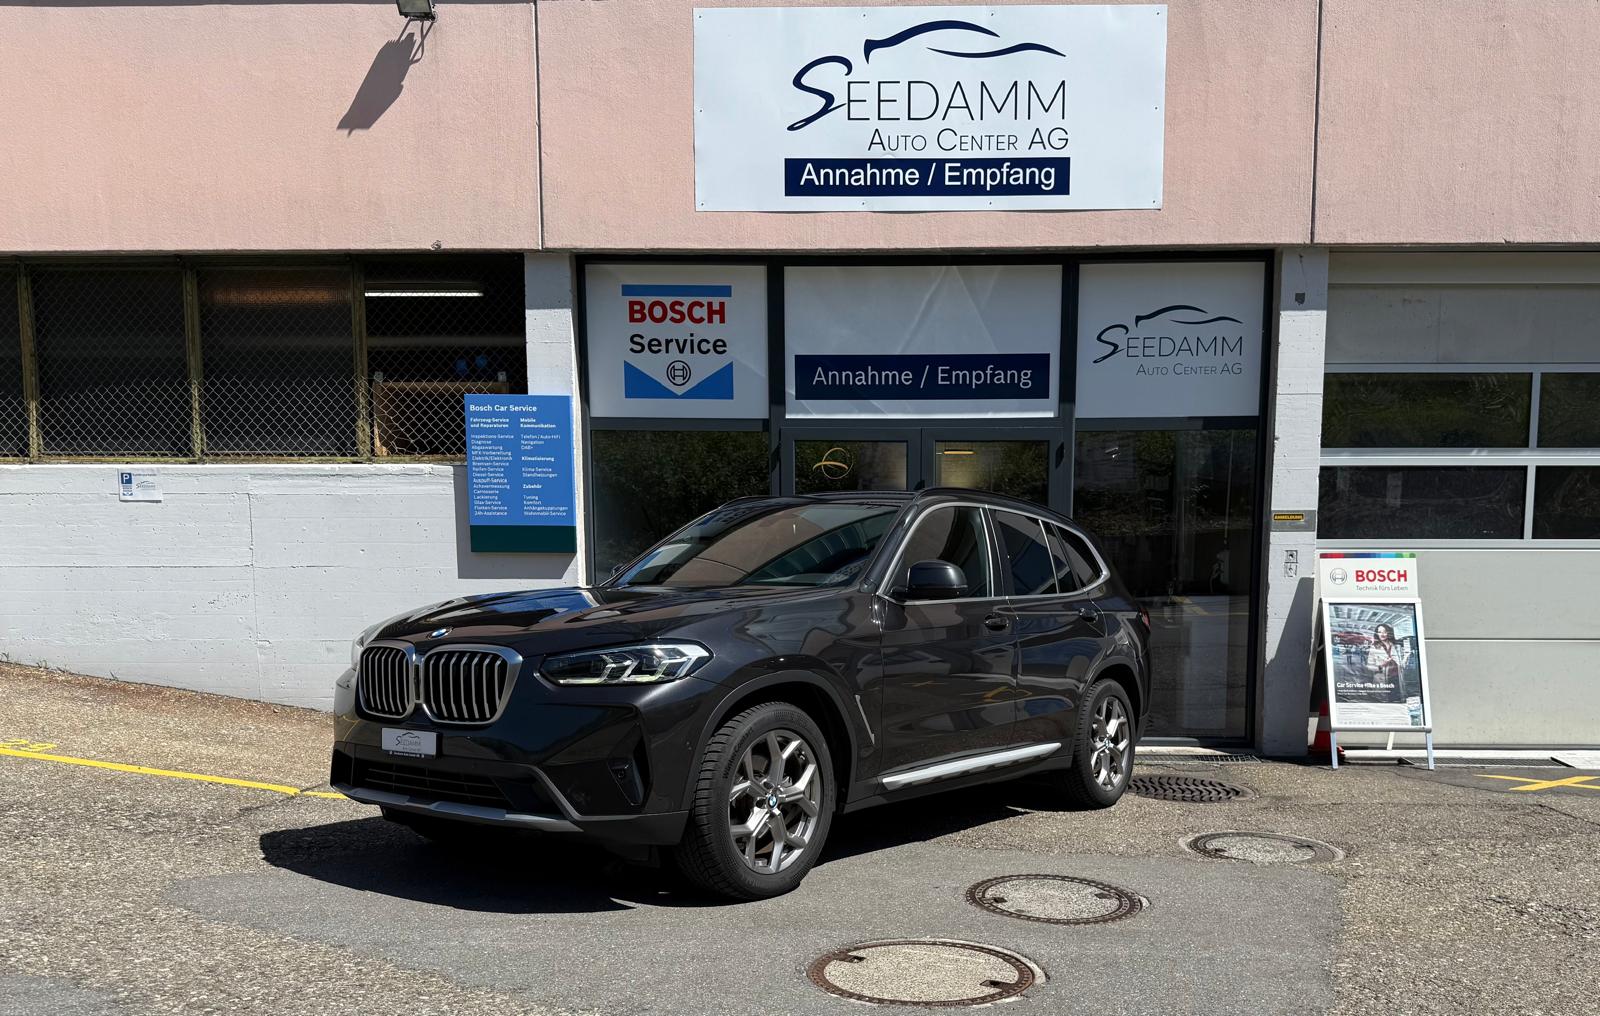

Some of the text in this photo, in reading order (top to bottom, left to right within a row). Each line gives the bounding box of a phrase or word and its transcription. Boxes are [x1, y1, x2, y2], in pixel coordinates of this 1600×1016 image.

[786, 55, 1066, 132] SEEDAMM
[867, 127, 1069, 152] AUTO CENTER AG
[800, 161, 1056, 190] Annahme / Empfang
[628, 300, 726, 324] BOSCH
[629, 333, 728, 355] Service
[1092, 323, 1243, 364] SEEDAMM
[812, 365, 1033, 389] Annahme / Empfang
[1136, 362, 1242, 376] AUTO CENTER AG
[469, 404, 538, 412] Bosch Car Service
[1355, 569, 1408, 583] BOSCH
